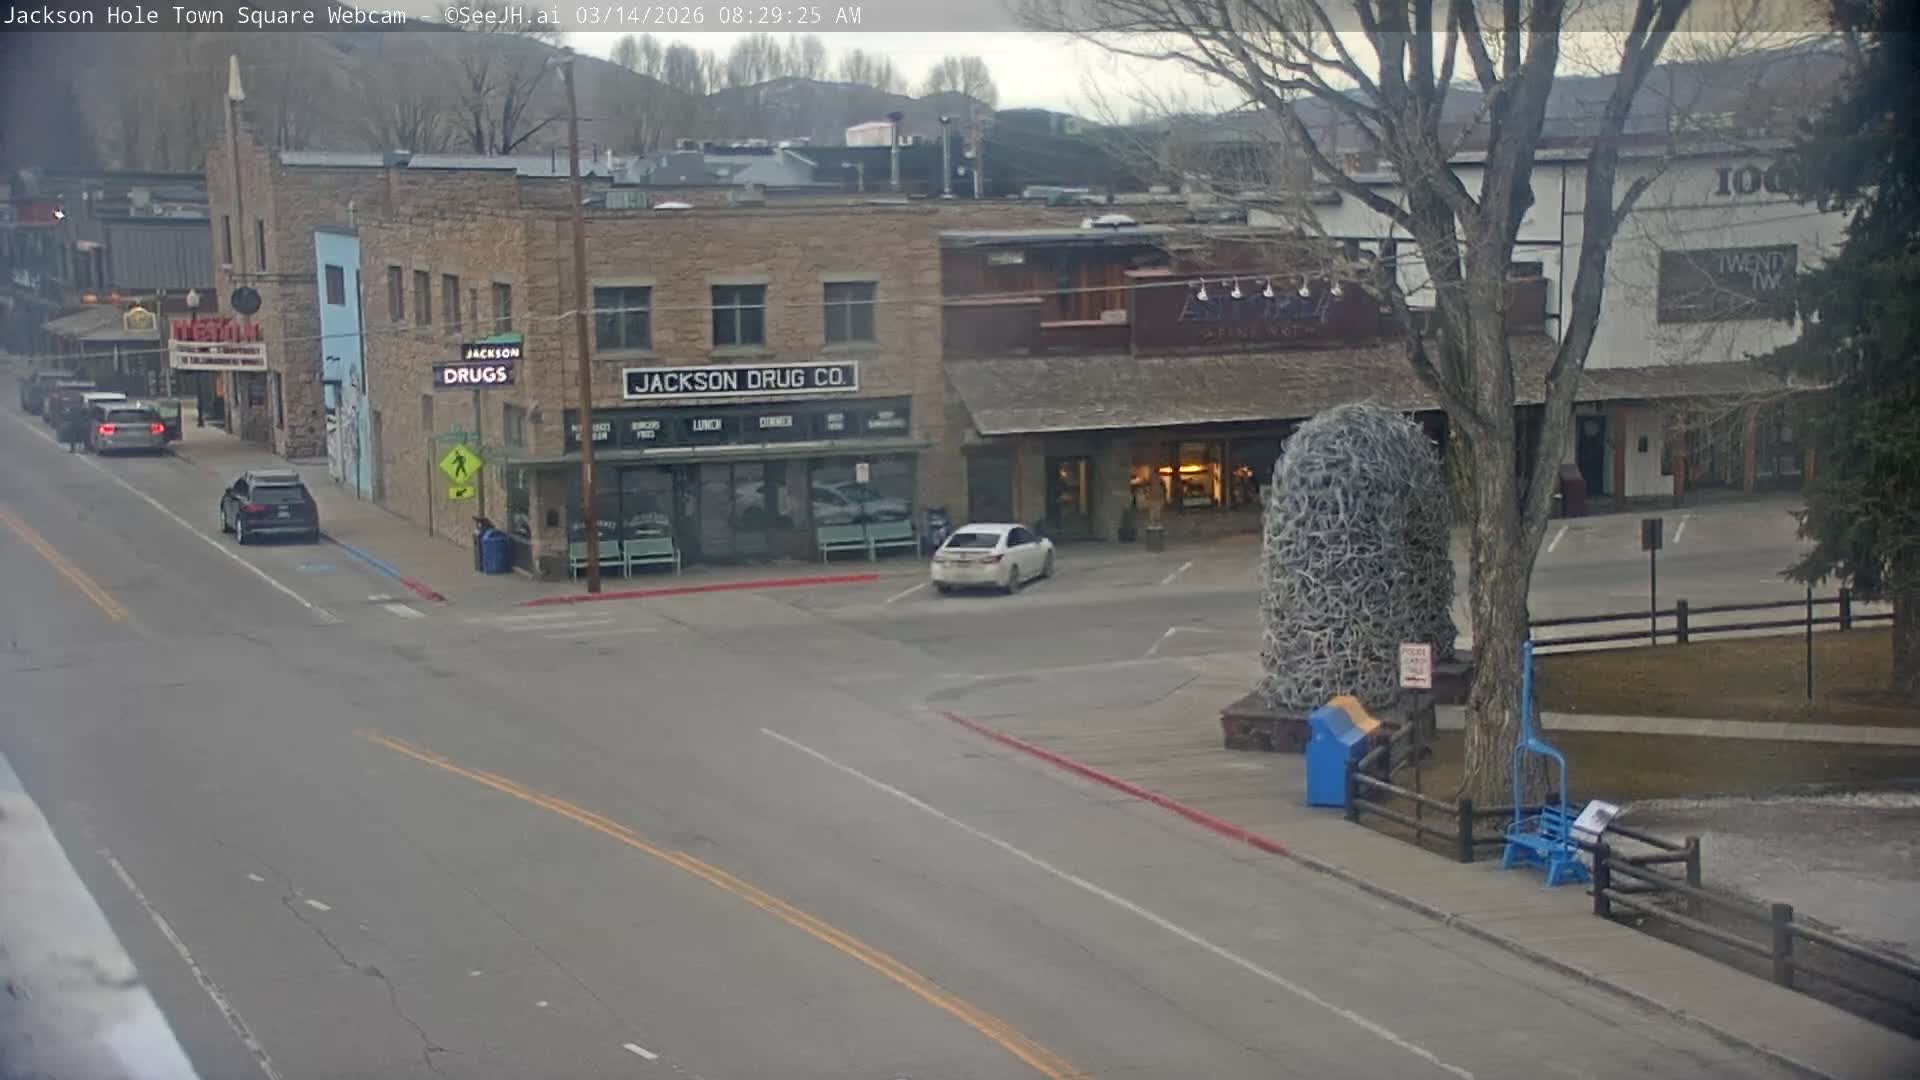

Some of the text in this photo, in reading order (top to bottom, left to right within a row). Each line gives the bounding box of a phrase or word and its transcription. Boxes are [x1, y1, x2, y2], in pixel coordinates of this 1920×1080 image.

[466, 347, 520, 360] JACKSON
[443, 366, 508, 384] DRUGS
[635, 367, 847, 393] JACKSON DRUG CO.
[692, 418, 723, 432] LUNCH
